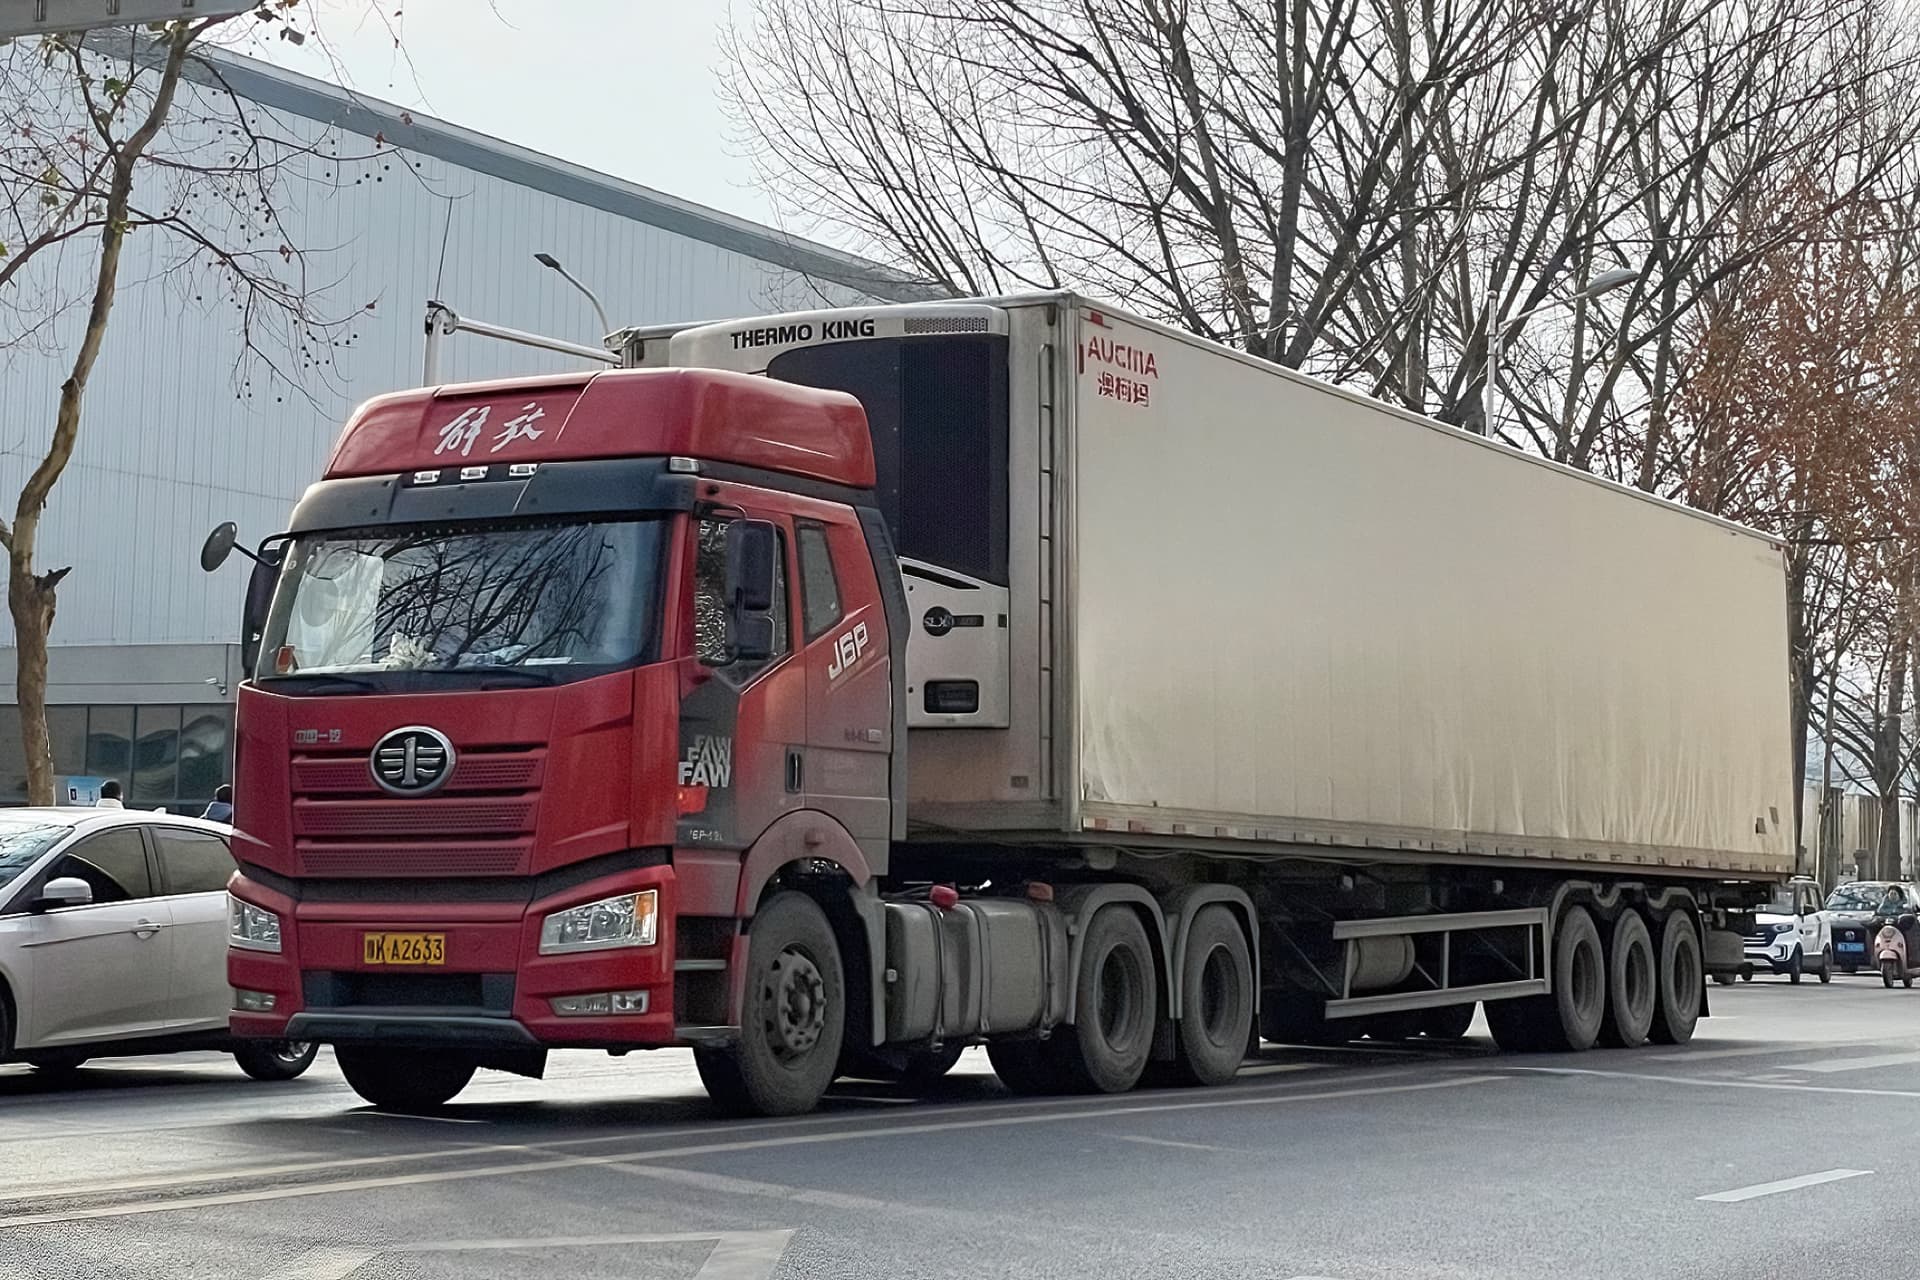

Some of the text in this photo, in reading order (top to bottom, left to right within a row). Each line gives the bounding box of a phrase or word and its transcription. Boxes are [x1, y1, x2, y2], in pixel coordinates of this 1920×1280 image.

[731, 319, 875, 349] THERMO KING
[1098, 371, 1149, 407] 澳柯玛
[434, 402, 545, 456] 解放
[828, 621, 869, 681] J6P
[678, 762, 731, 788] FAW
